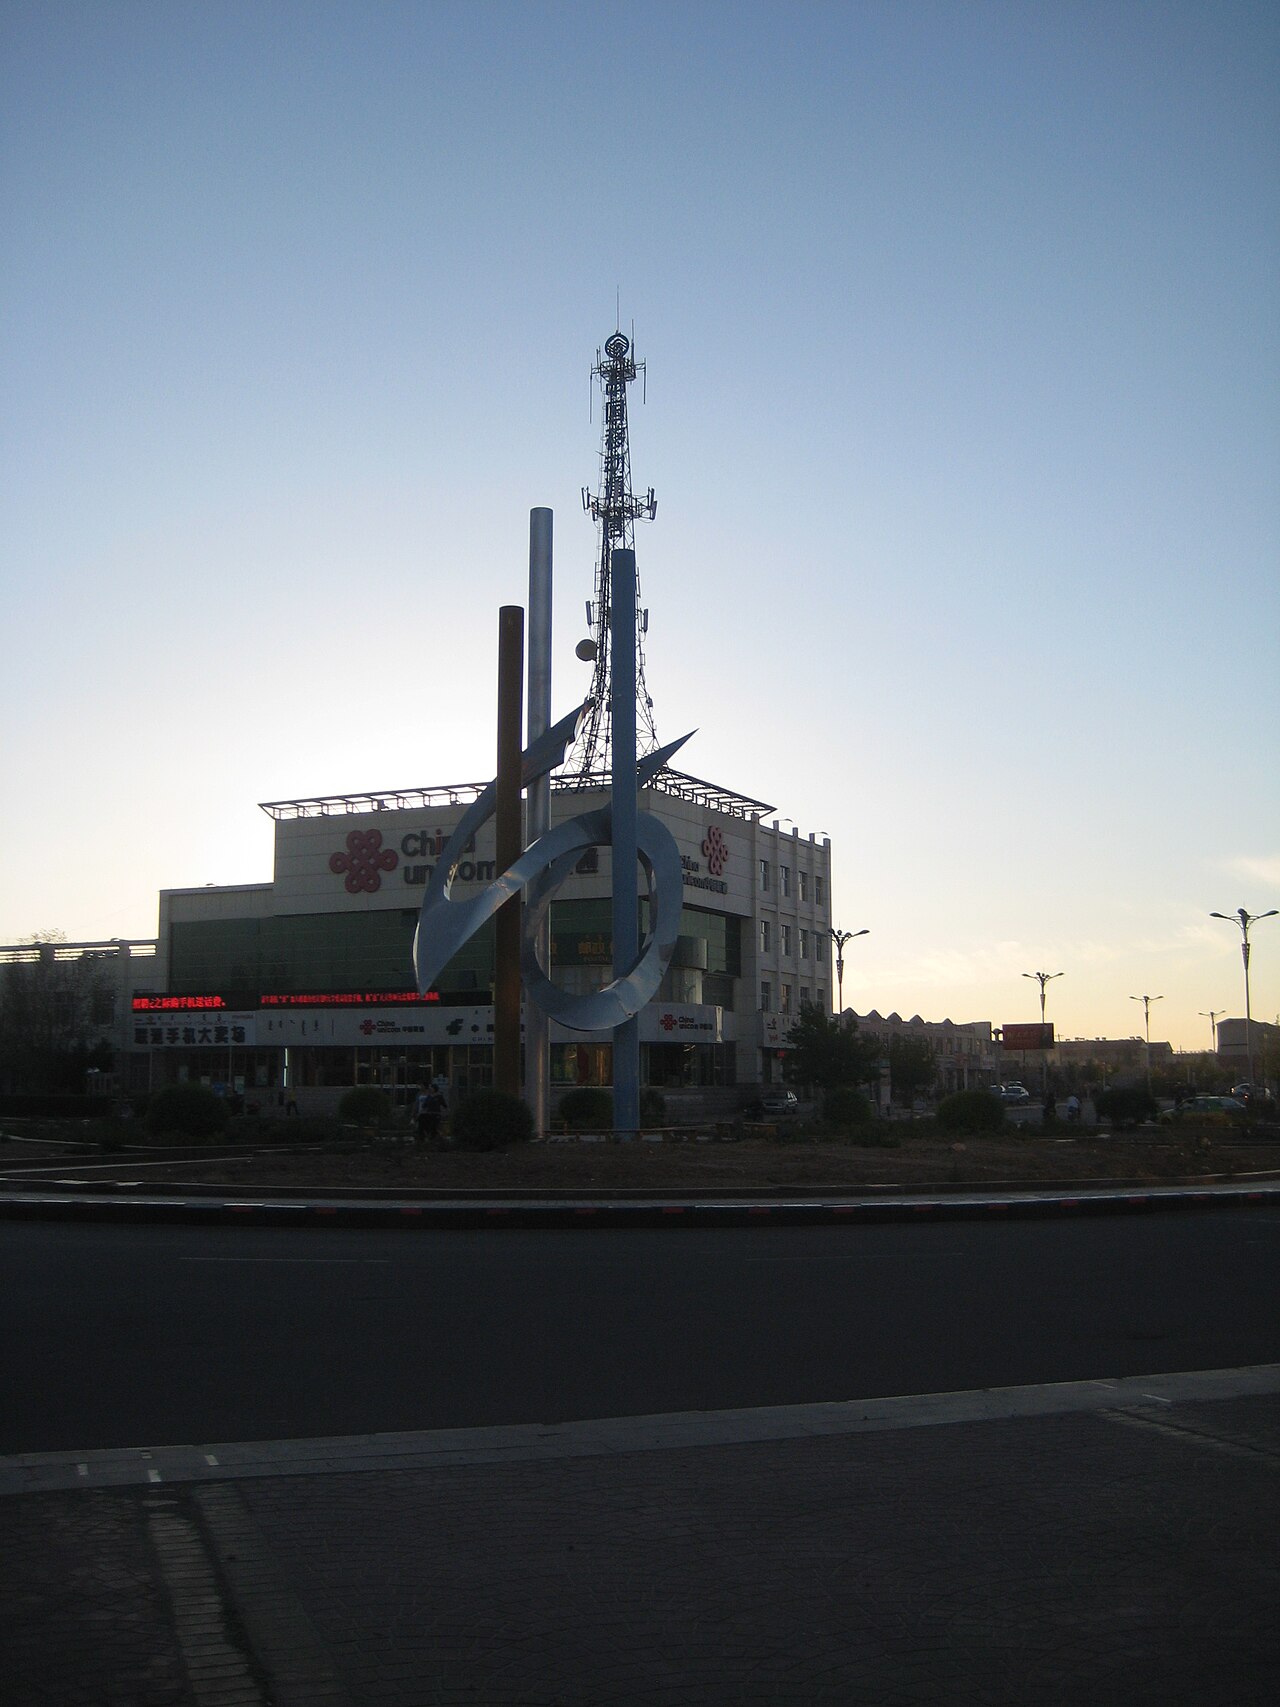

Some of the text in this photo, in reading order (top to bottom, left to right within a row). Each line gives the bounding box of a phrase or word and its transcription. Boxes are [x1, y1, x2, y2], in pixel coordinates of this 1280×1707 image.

[404, 857, 496, 884] unom
[134, 1025, 246, 1045] 联通手机大卖场
